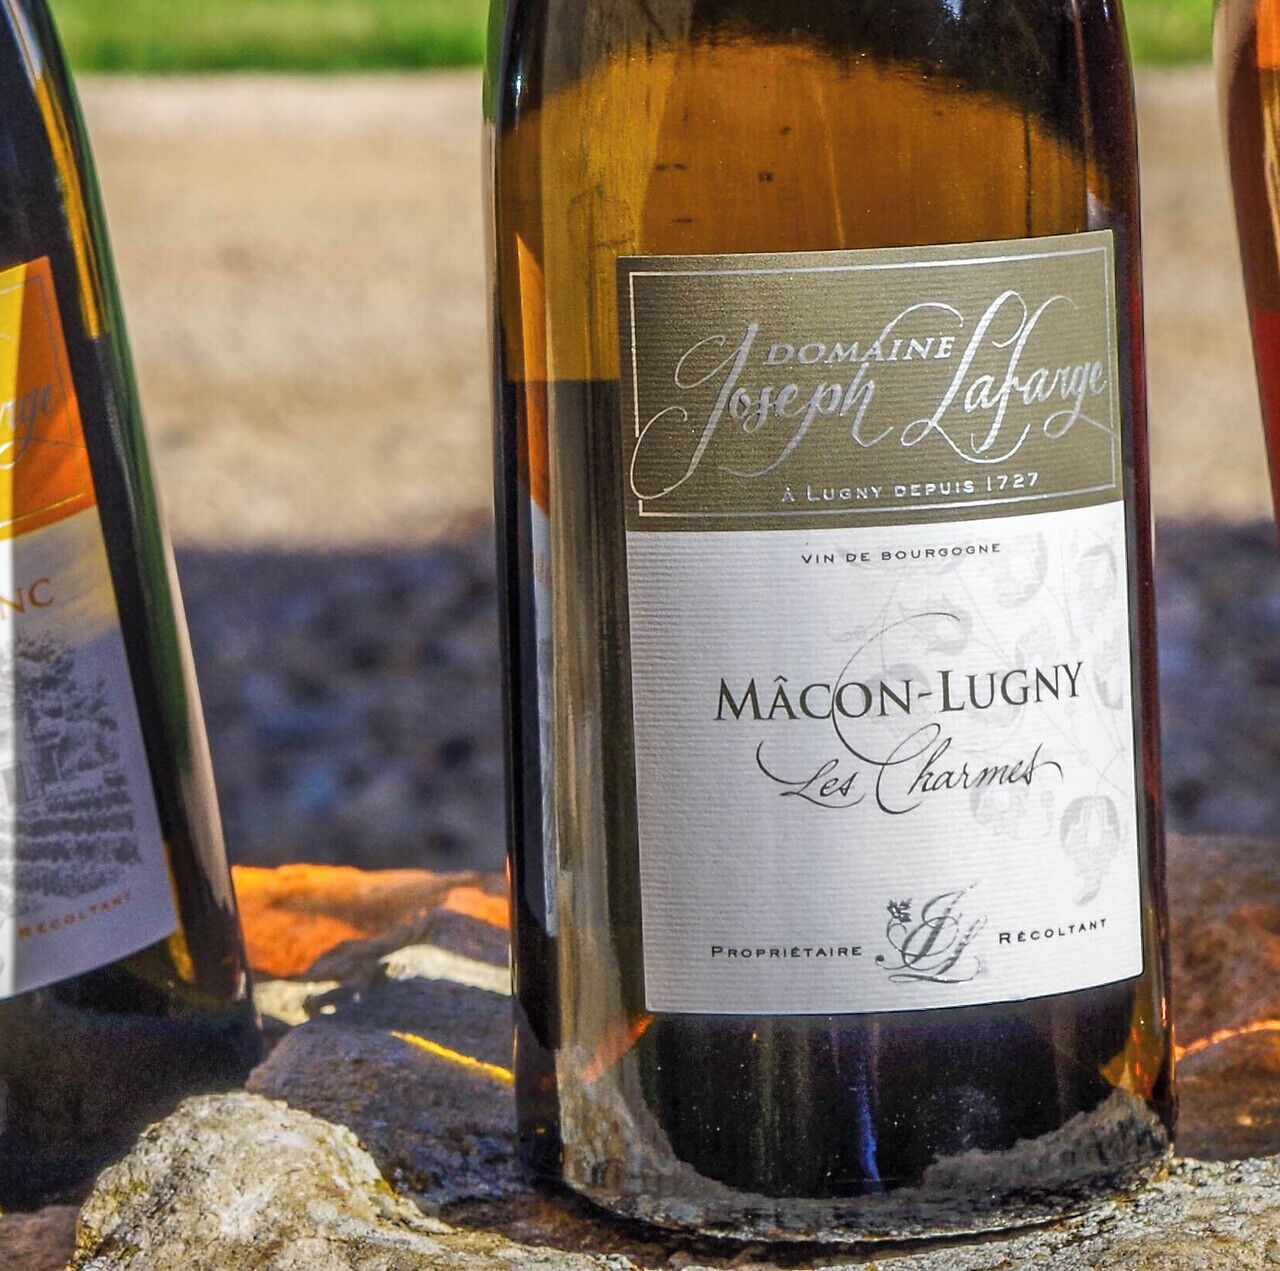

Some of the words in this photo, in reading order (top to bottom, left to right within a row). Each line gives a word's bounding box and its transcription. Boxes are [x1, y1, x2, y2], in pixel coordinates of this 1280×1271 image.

[763, 334, 957, 367] DOMAINE
[630, 302, 964, 501] Joseph
[900, 290, 1118, 465] Lafarge
[781, 484, 796, 503] À
[805, 483, 883, 503] LUGNY
[894, 479, 975, 499] DEPUIS
[985, 471, 1040, 493] 1727
[800, 552, 836, 566] VIN
[845, 550, 872, 564] DE
[880, 542, 1002, 562] BOURGOGNE
[713, 660, 1085, 722] MÂCON-LUGNY
[755, 739, 866, 809] Les
[831, 611, 1065, 816] Charmes
[711, 944, 863, 960] PROPRIÉTAIRE
[998, 918, 1109, 946] RÉCOLTANT
